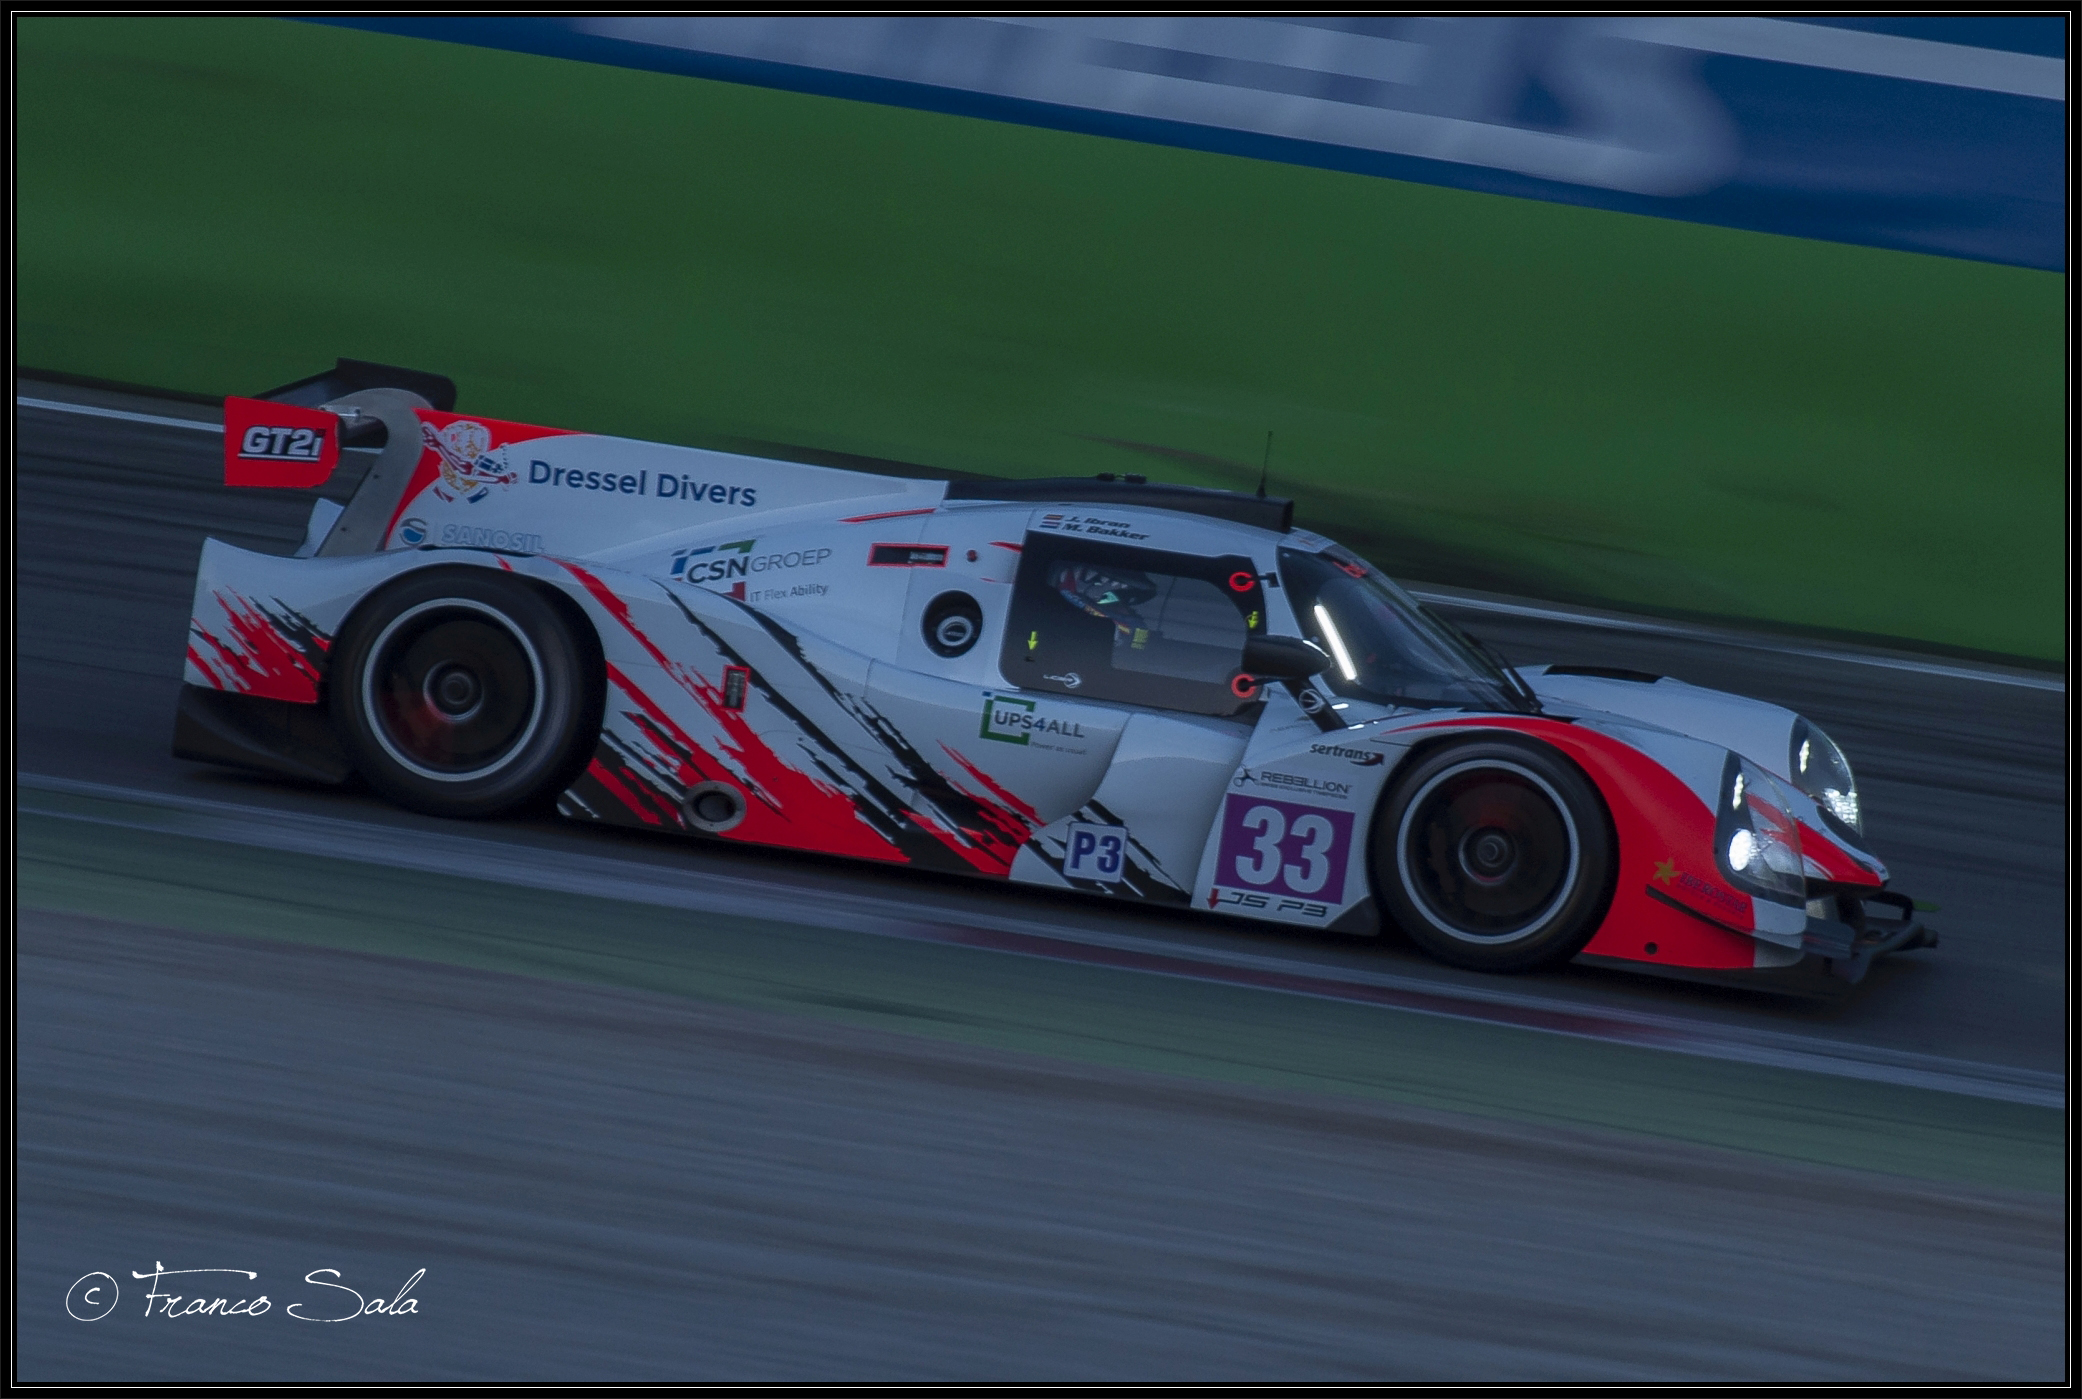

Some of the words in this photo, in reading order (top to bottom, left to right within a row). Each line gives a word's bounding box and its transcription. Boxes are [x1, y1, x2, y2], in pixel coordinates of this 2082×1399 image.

[241, 425, 325, 457] GT2i
[528, 459, 647, 495] Dressel
[656, 473, 757, 507] Divers
[442, 523, 545, 550] SANOSIL
[1062, 523, 1082, 532] M.
[1086, 525, 1150, 540] Bakker
[750, 591, 762, 602] IT
[765, 589, 787, 601] Flex
[790, 584, 829, 597] Ability
[994, 710, 1084, 738] UPS4ALL
[1310, 743, 1373, 761] sertrans
[1071, 831, 1121, 873] P3
[1235, 805, 1335, 894] 33
[1277, 900, 1328, 918] P3
